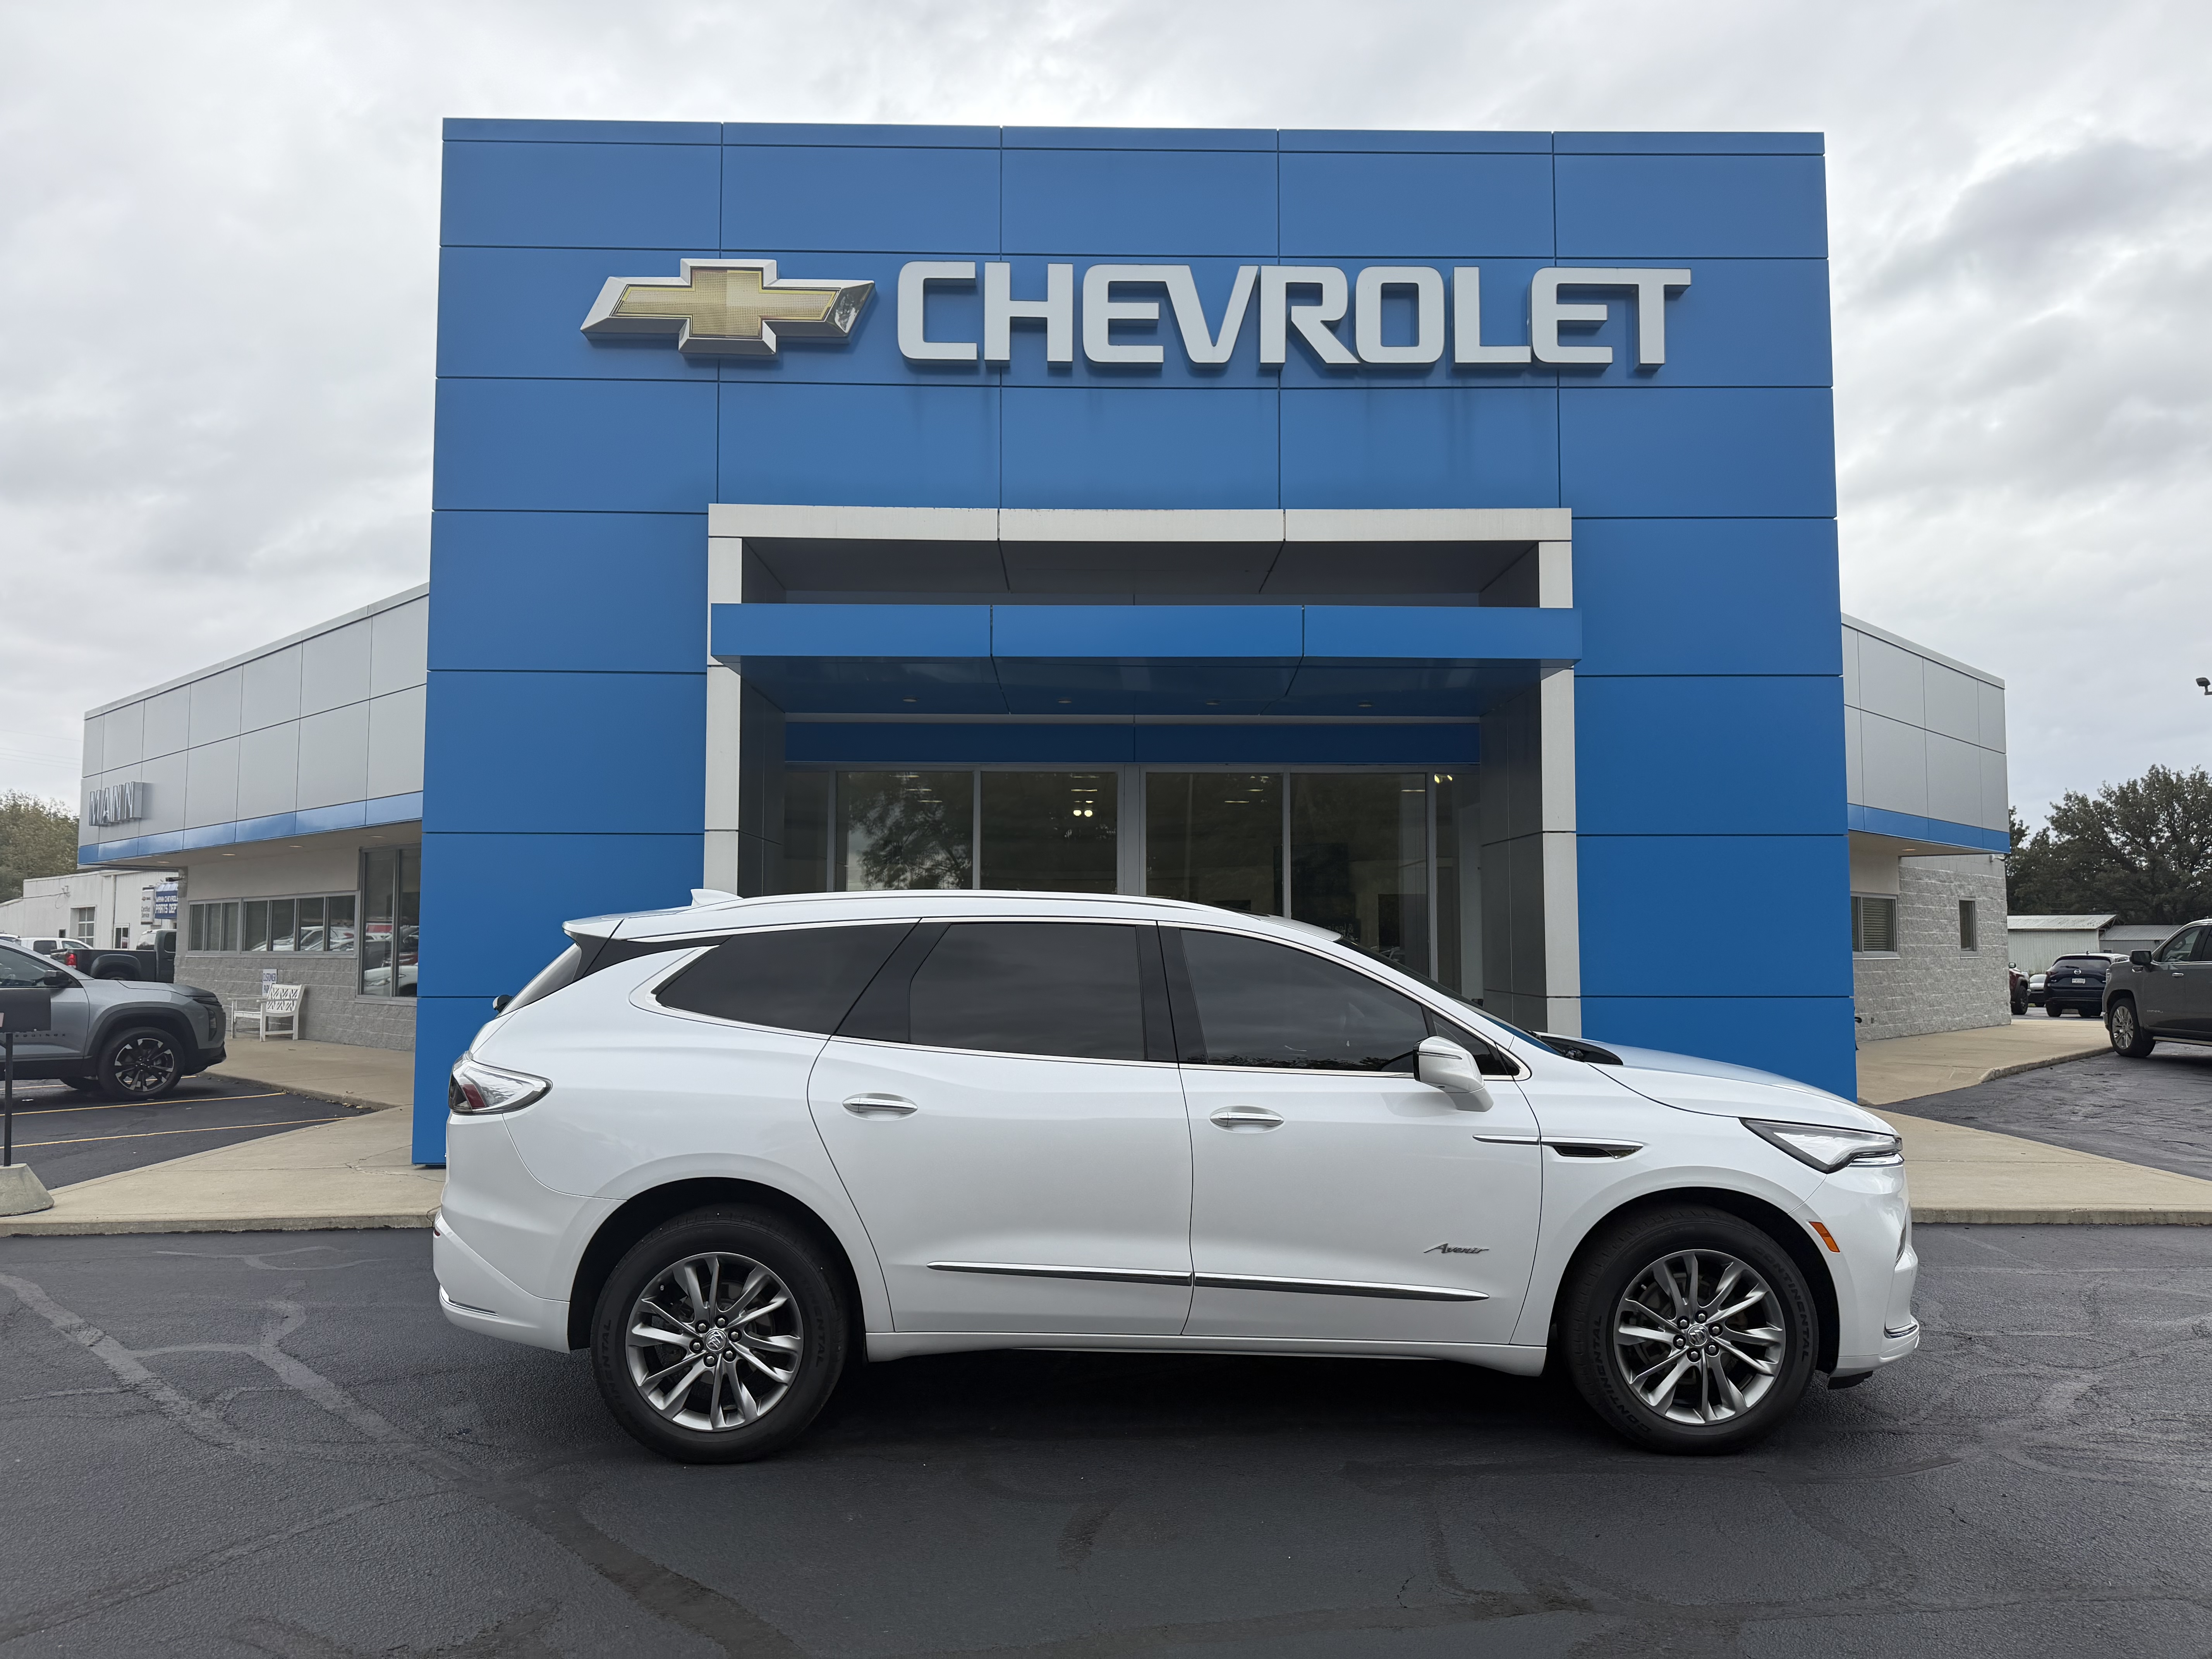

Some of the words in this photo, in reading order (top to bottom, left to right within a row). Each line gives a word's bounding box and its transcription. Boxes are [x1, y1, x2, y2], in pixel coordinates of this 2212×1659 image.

[897, 261, 1691, 364] CHEVROLET
[89, 781, 136, 826] MANN
[155, 903, 168, 914] PARTS
[1423, 1243, 1489, 1254] Avenir
